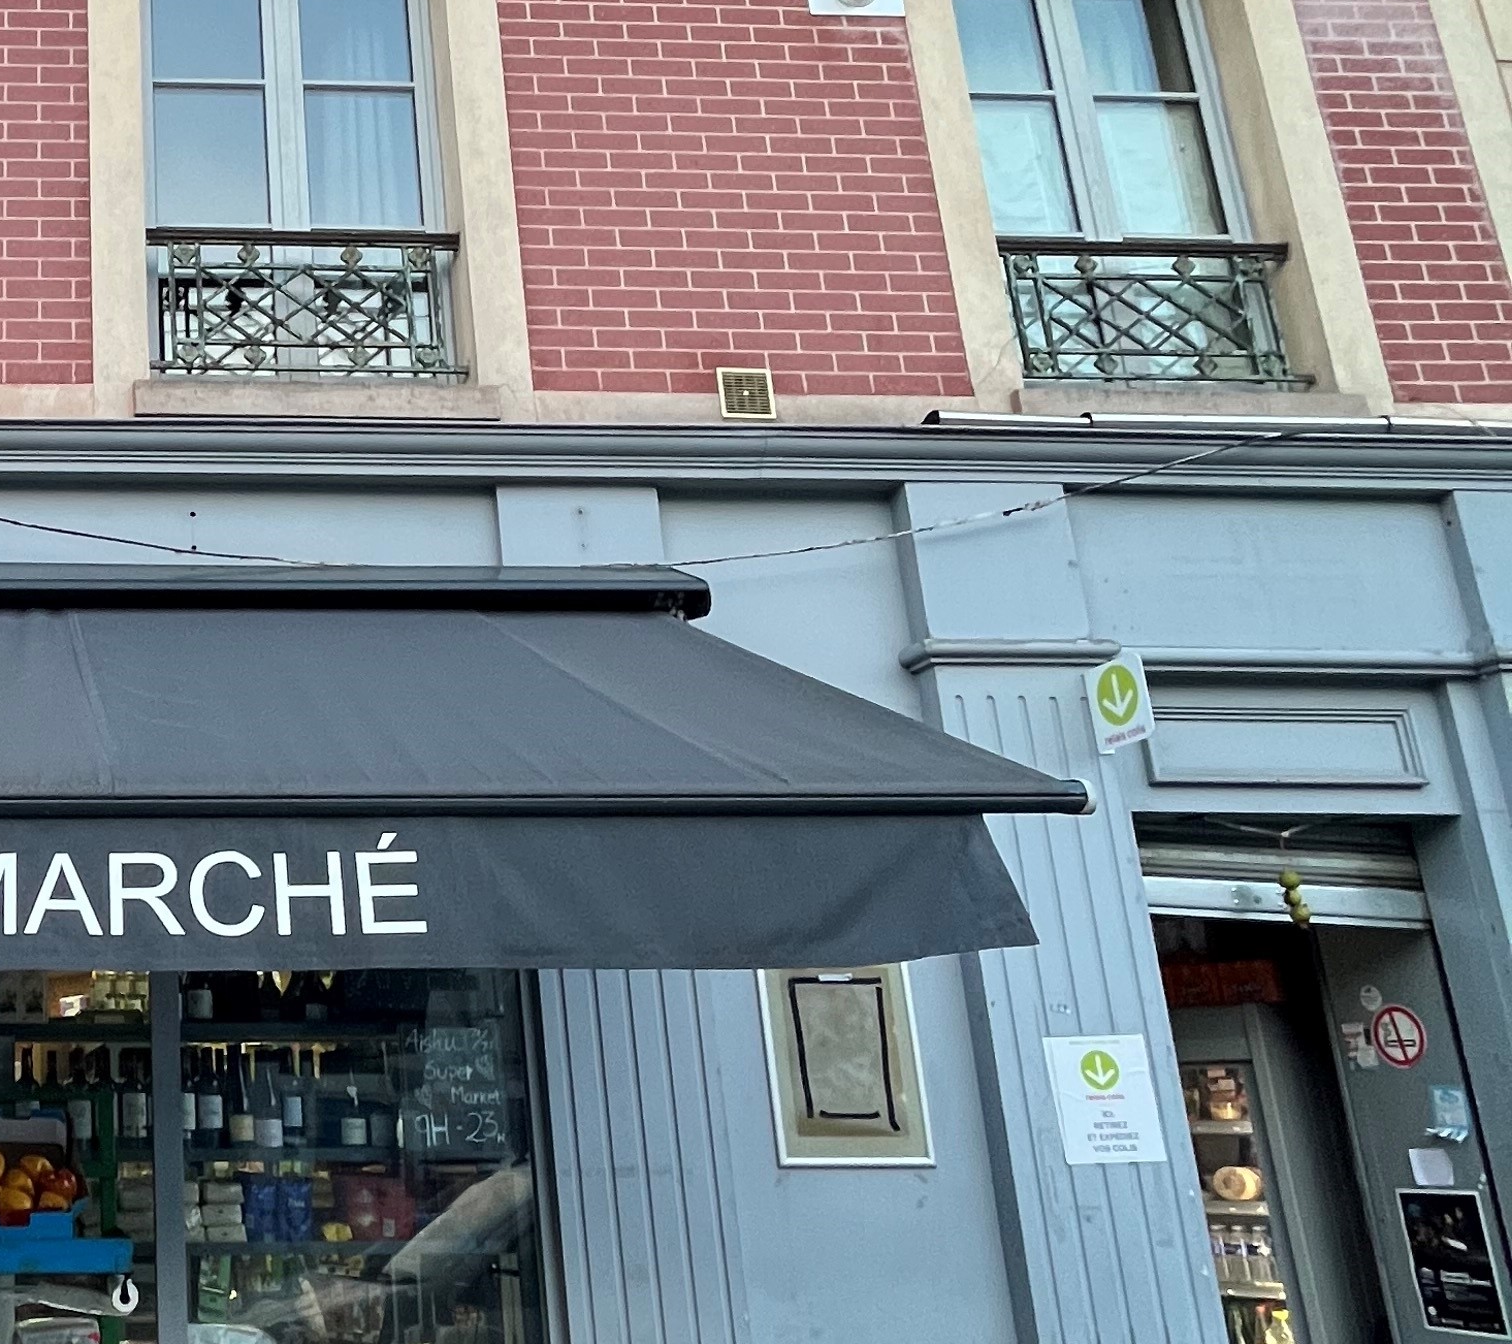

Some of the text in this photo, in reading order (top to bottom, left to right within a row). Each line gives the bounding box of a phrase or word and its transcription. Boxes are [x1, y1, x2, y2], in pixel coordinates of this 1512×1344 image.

[423, 1060, 473, 1081] Super
[450, 1086, 500, 1105] Market
[414, 1113, 450, 1148] 9H
